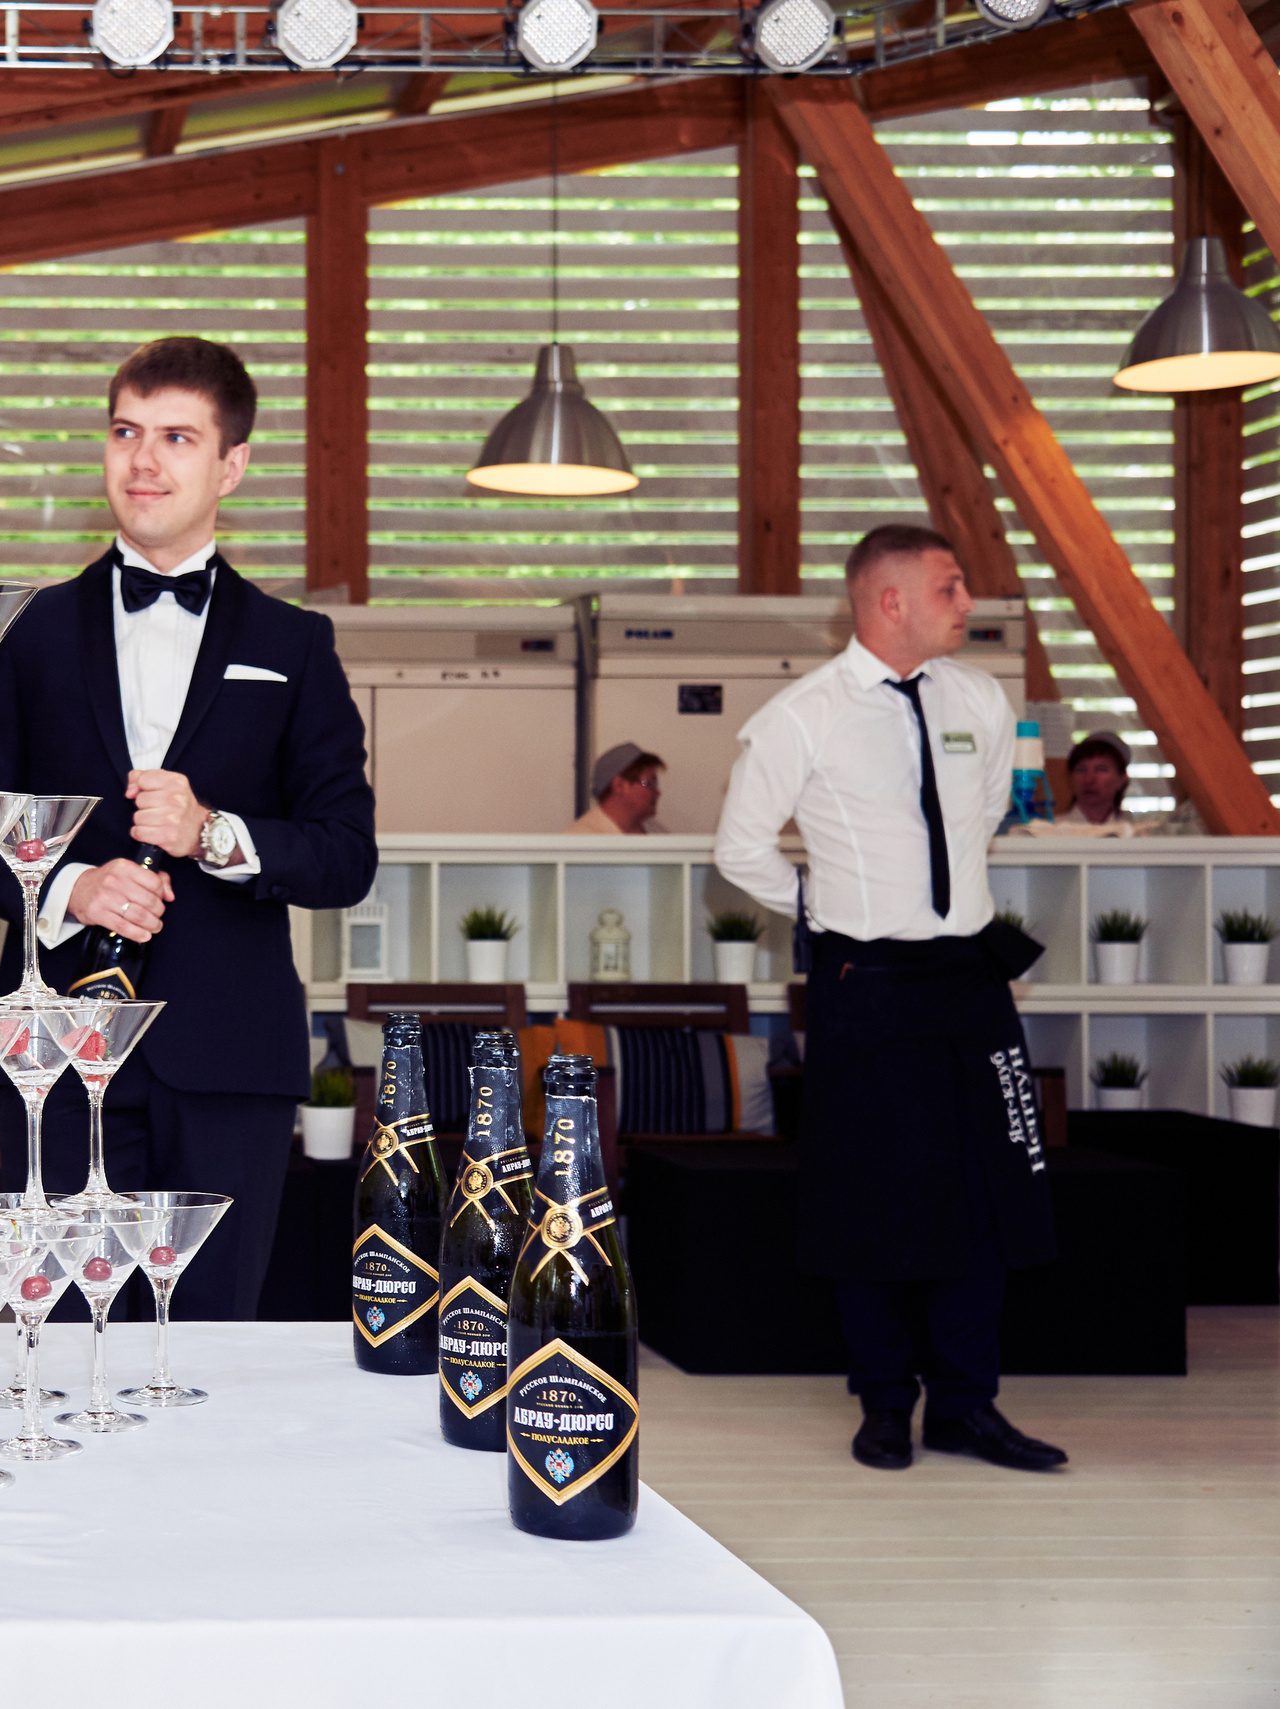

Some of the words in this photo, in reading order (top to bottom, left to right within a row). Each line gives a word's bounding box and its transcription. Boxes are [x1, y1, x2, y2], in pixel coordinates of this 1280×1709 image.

[383, 1060, 397, 1105] 1870
[476, 1086, 493, 1138] 1870
[1007, 1045, 1047, 1174] Нептун
[553, 1118, 575, 1177] 1870
[365, 1261, 387, 1272] 1870
[442, 1307, 462, 1326] РУССКОЕ
[462, 1307, 508, 1330] ШАМПАНСКО
[457, 1319, 484, 1331] 1870
[440, 1334, 508, 1357] АБРАУ-ДЮРС
[519, 1376, 548, 1397] РУССКОЕ
[548, 1374, 608, 1404] ШАМПАНСКОЕ
[542, 1389, 577, 1402] 1870
[513, 1406, 615, 1433] АБРАУ-ДЮРСО
[531, 1433, 590, 1445] ПОЛУСЛАДКОЕ
